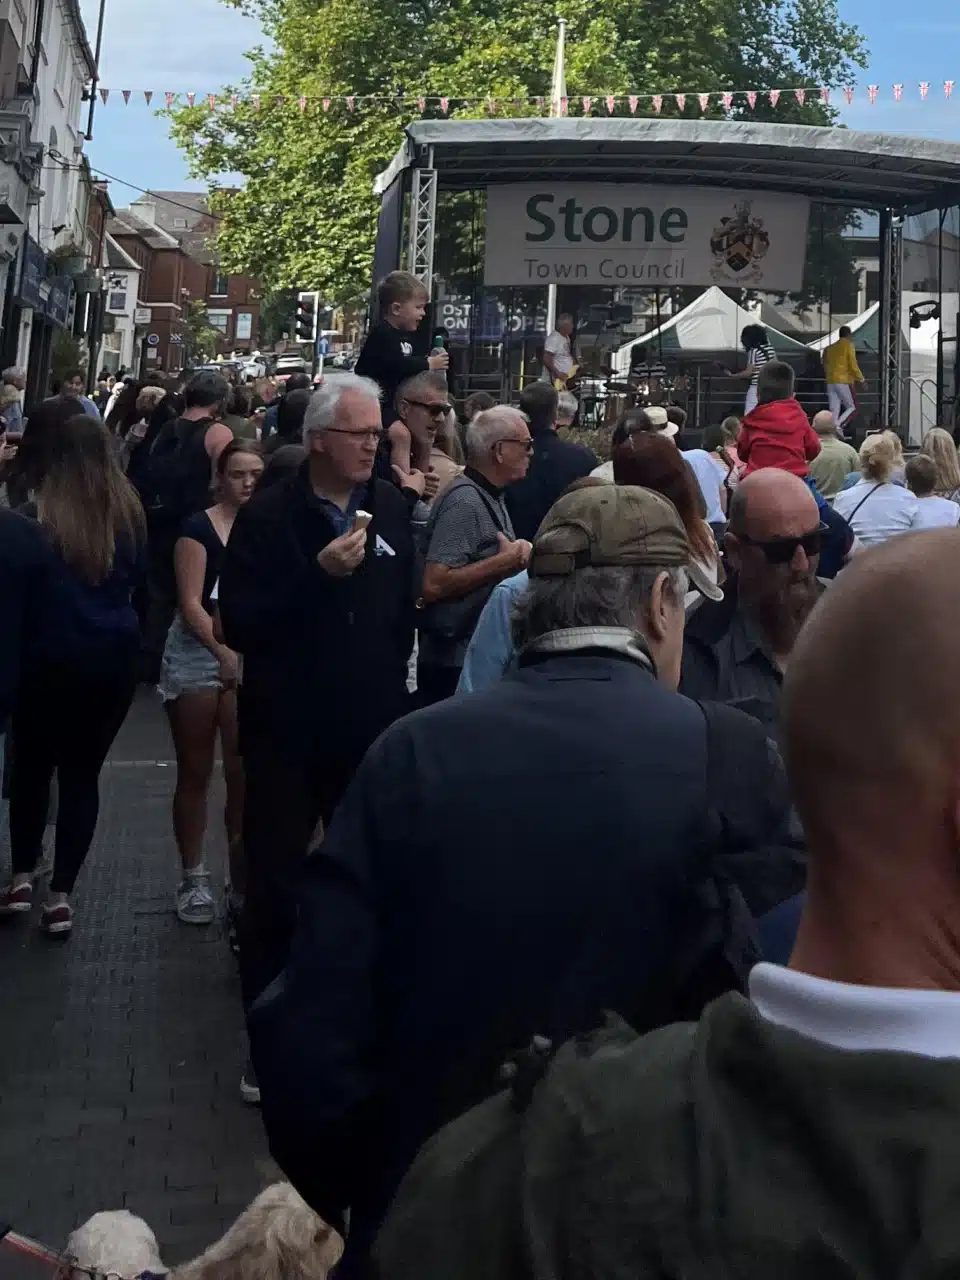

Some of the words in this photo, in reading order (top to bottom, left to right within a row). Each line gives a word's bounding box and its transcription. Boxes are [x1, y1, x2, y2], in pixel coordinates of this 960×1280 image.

[524, 192, 689, 243] Stone
[523, 258, 589, 279] Town
[598, 258, 686, 279] Council
